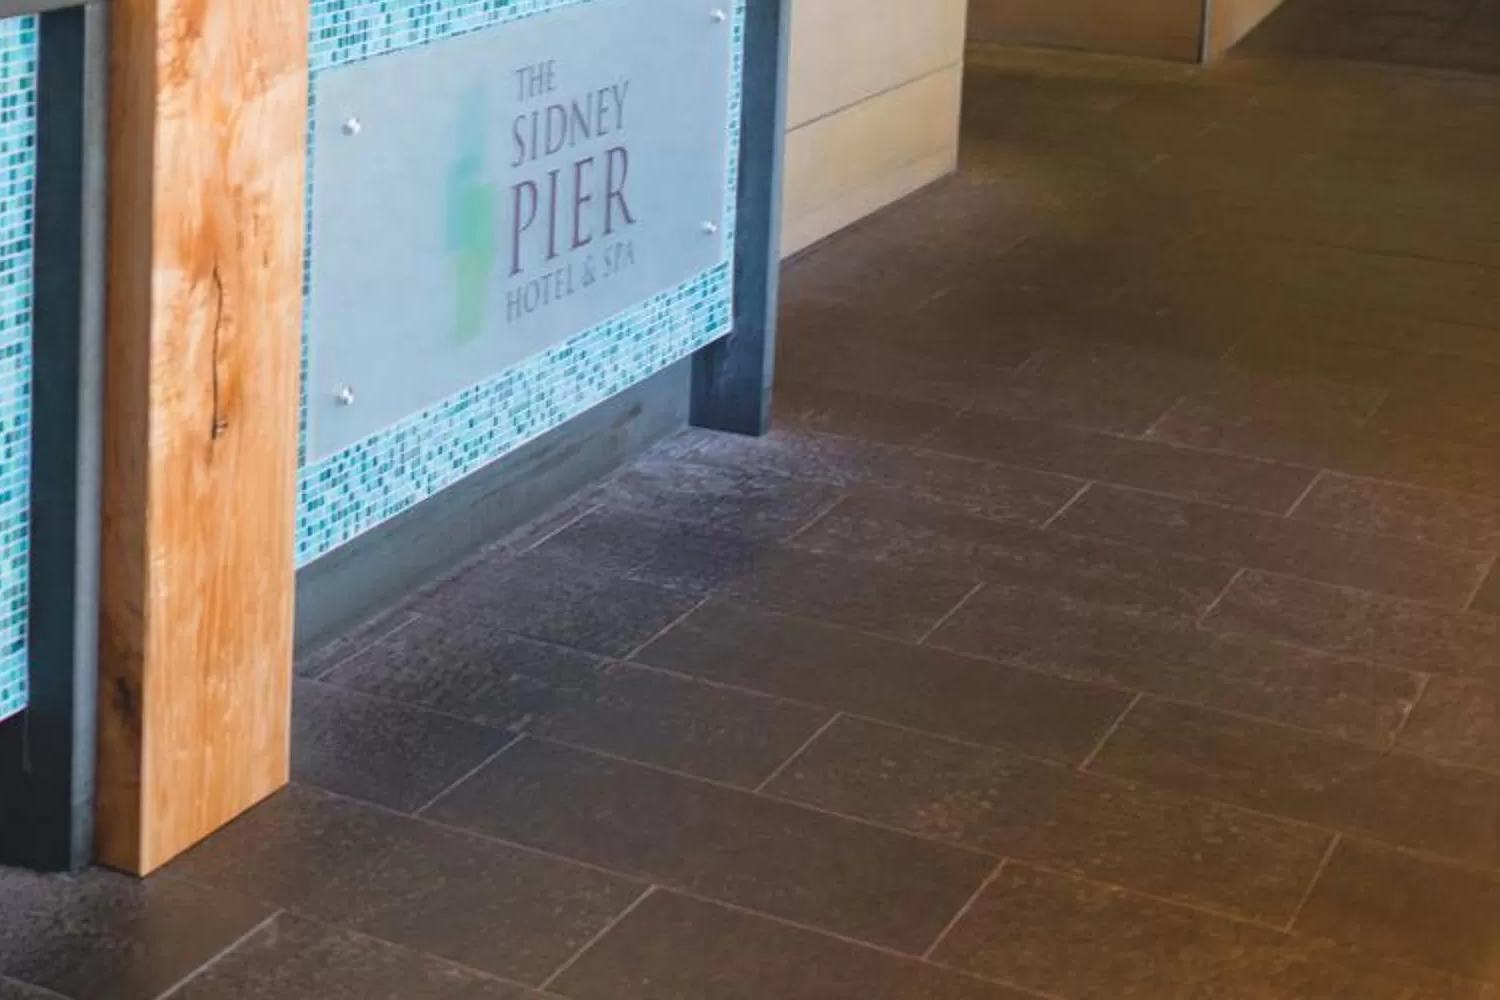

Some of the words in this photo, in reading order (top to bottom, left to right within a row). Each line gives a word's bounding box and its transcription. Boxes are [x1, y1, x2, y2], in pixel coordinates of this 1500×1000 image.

[515, 59, 557, 101] THE
[510, 80, 630, 168] SIDNEY
[508, 146, 637, 277] PIER
[506, 263, 575, 324] HOTEL
[581, 253, 597, 288] &
[602, 238, 635, 280] SPA
